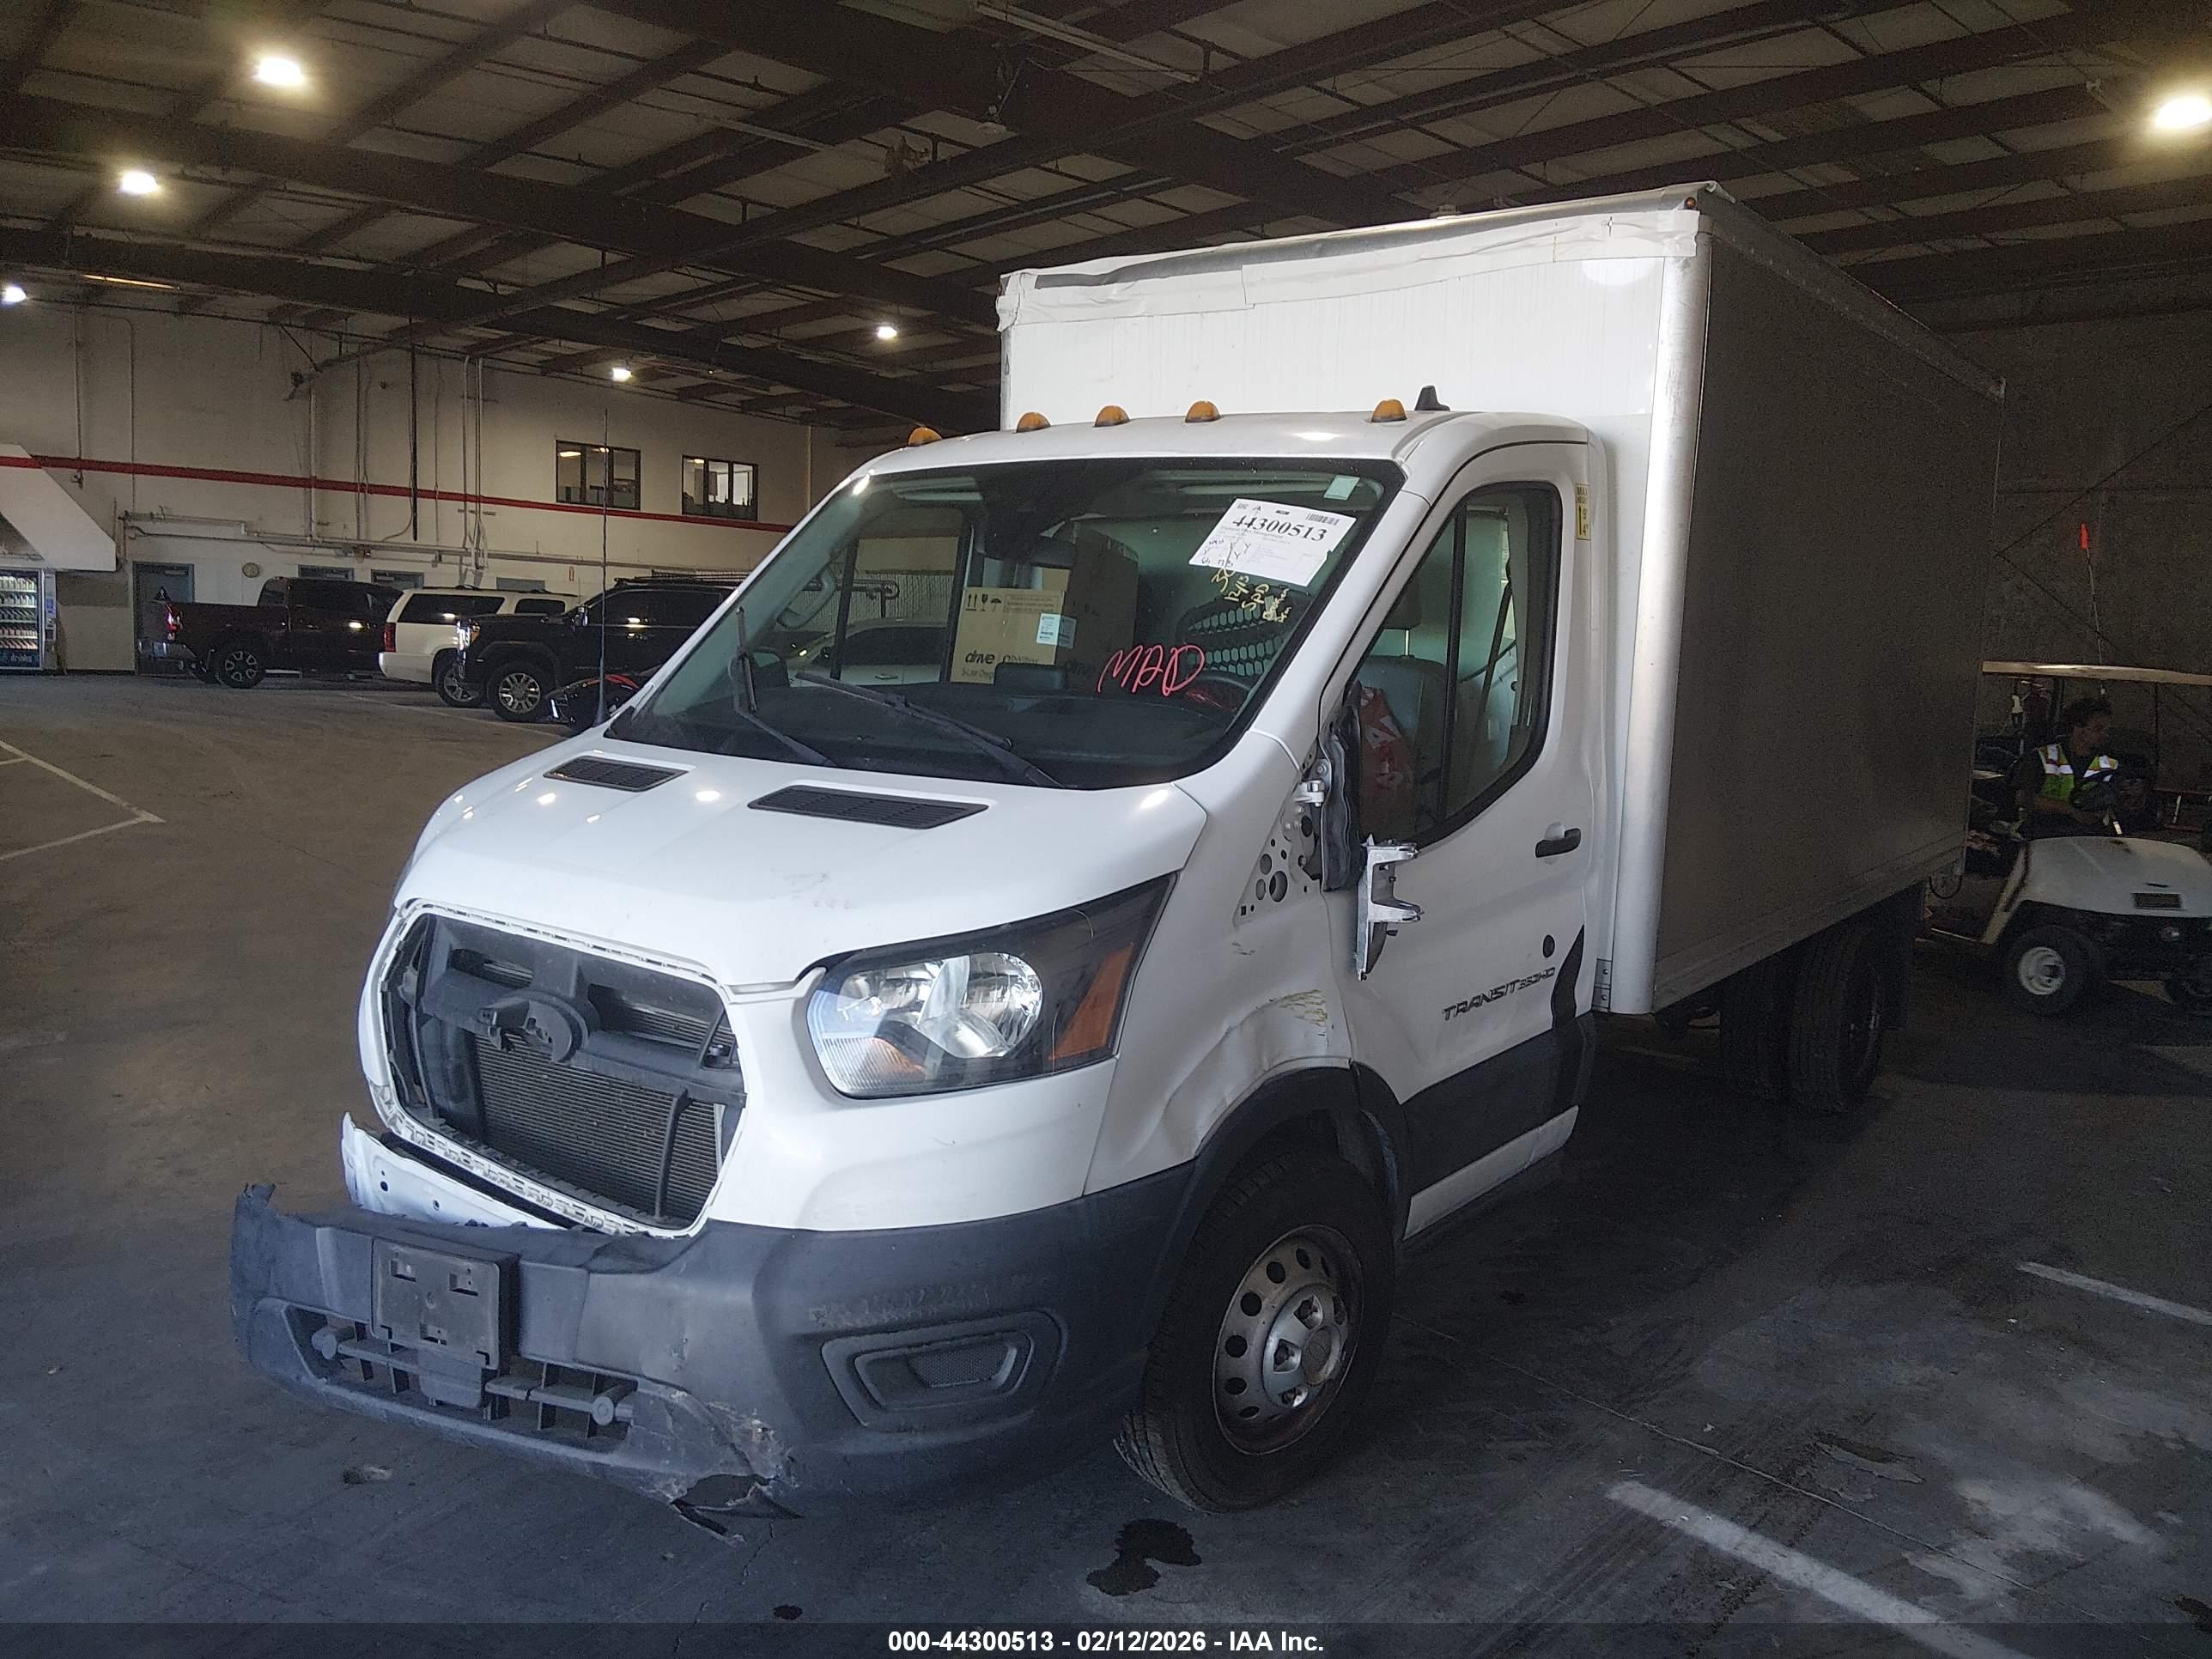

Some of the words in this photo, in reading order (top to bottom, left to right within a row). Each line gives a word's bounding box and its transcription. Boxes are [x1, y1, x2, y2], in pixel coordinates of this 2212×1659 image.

[1232, 515, 1328, 542] 44300513
[964, 650, 995, 665] drive
[1442, 979, 1519, 1021] TRANSIT
